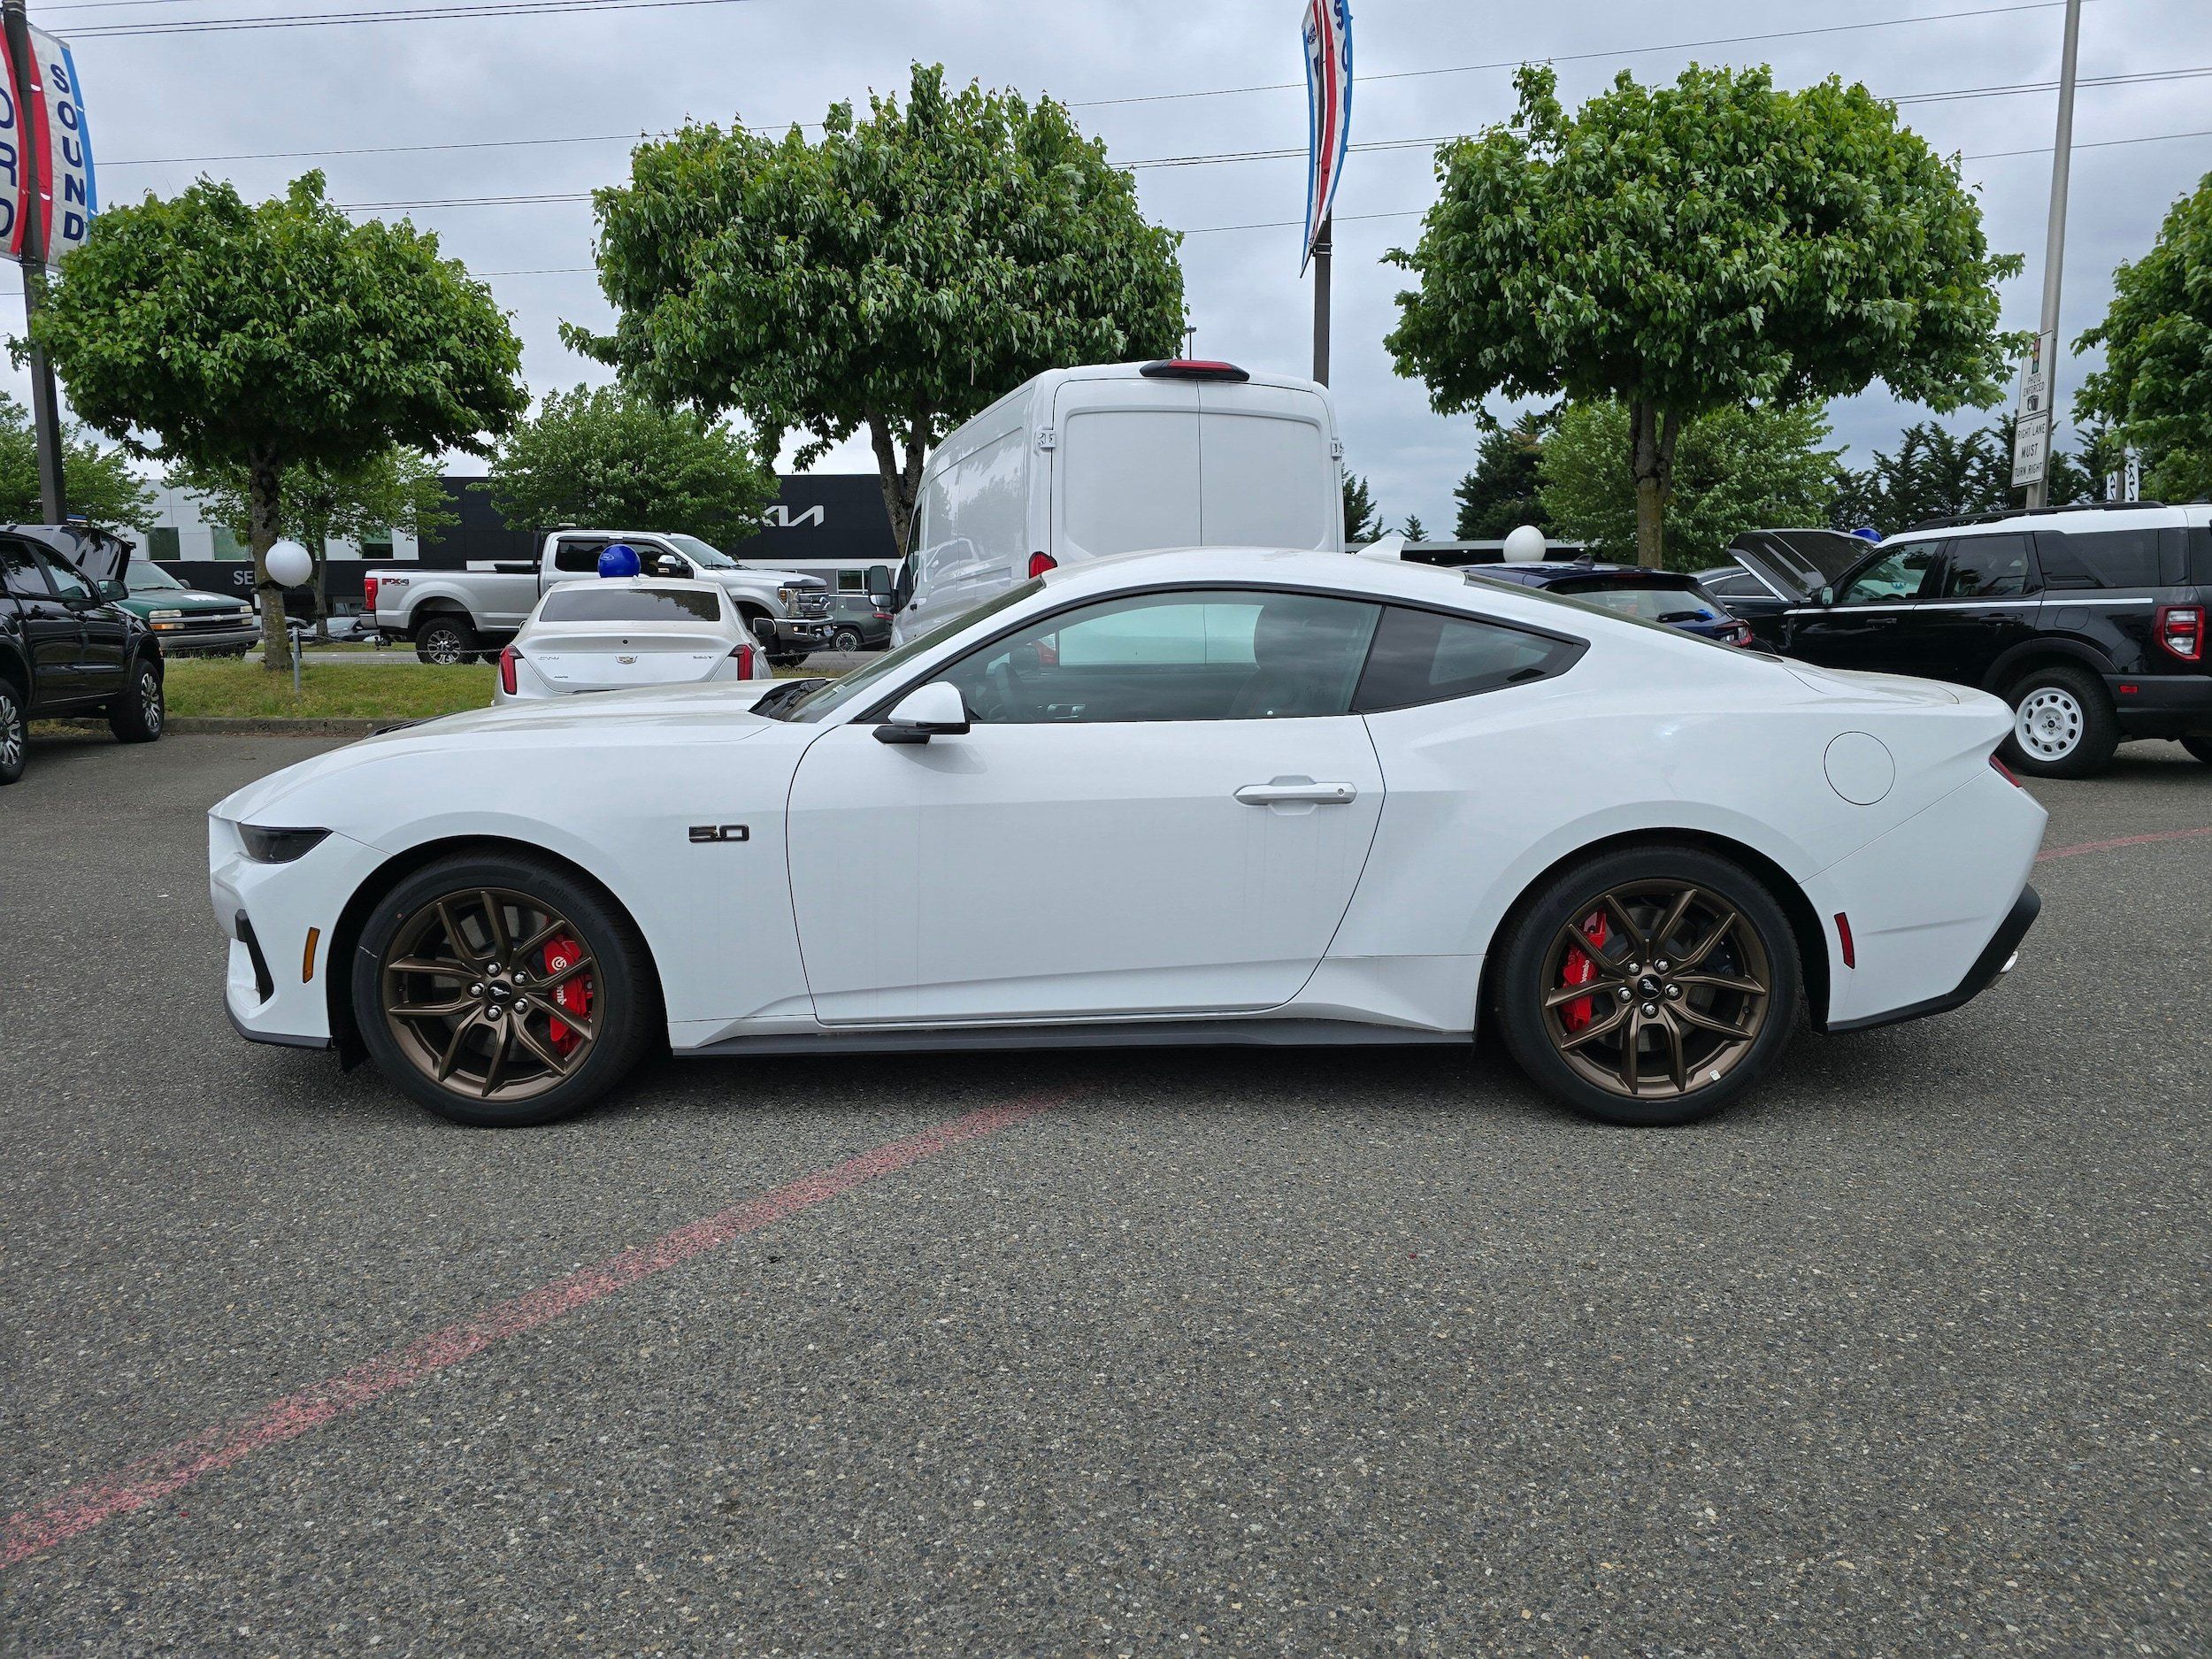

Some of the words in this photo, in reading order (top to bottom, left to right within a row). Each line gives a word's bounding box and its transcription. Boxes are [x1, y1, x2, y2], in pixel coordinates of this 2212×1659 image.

[50, 64, 86, 241] SOUND
[2024, 381, 2045, 396] ENFORCED
[2017, 427, 2031, 441] RIGHT
[2032, 423, 2046, 436] LANE
[2021, 443, 2039, 458] MUST
[2015, 465, 2027, 478] TURN
[2028, 462, 2042, 475] RIGHT
[233, 571, 254, 585] SE
[689, 825, 749, 842] 5.0
